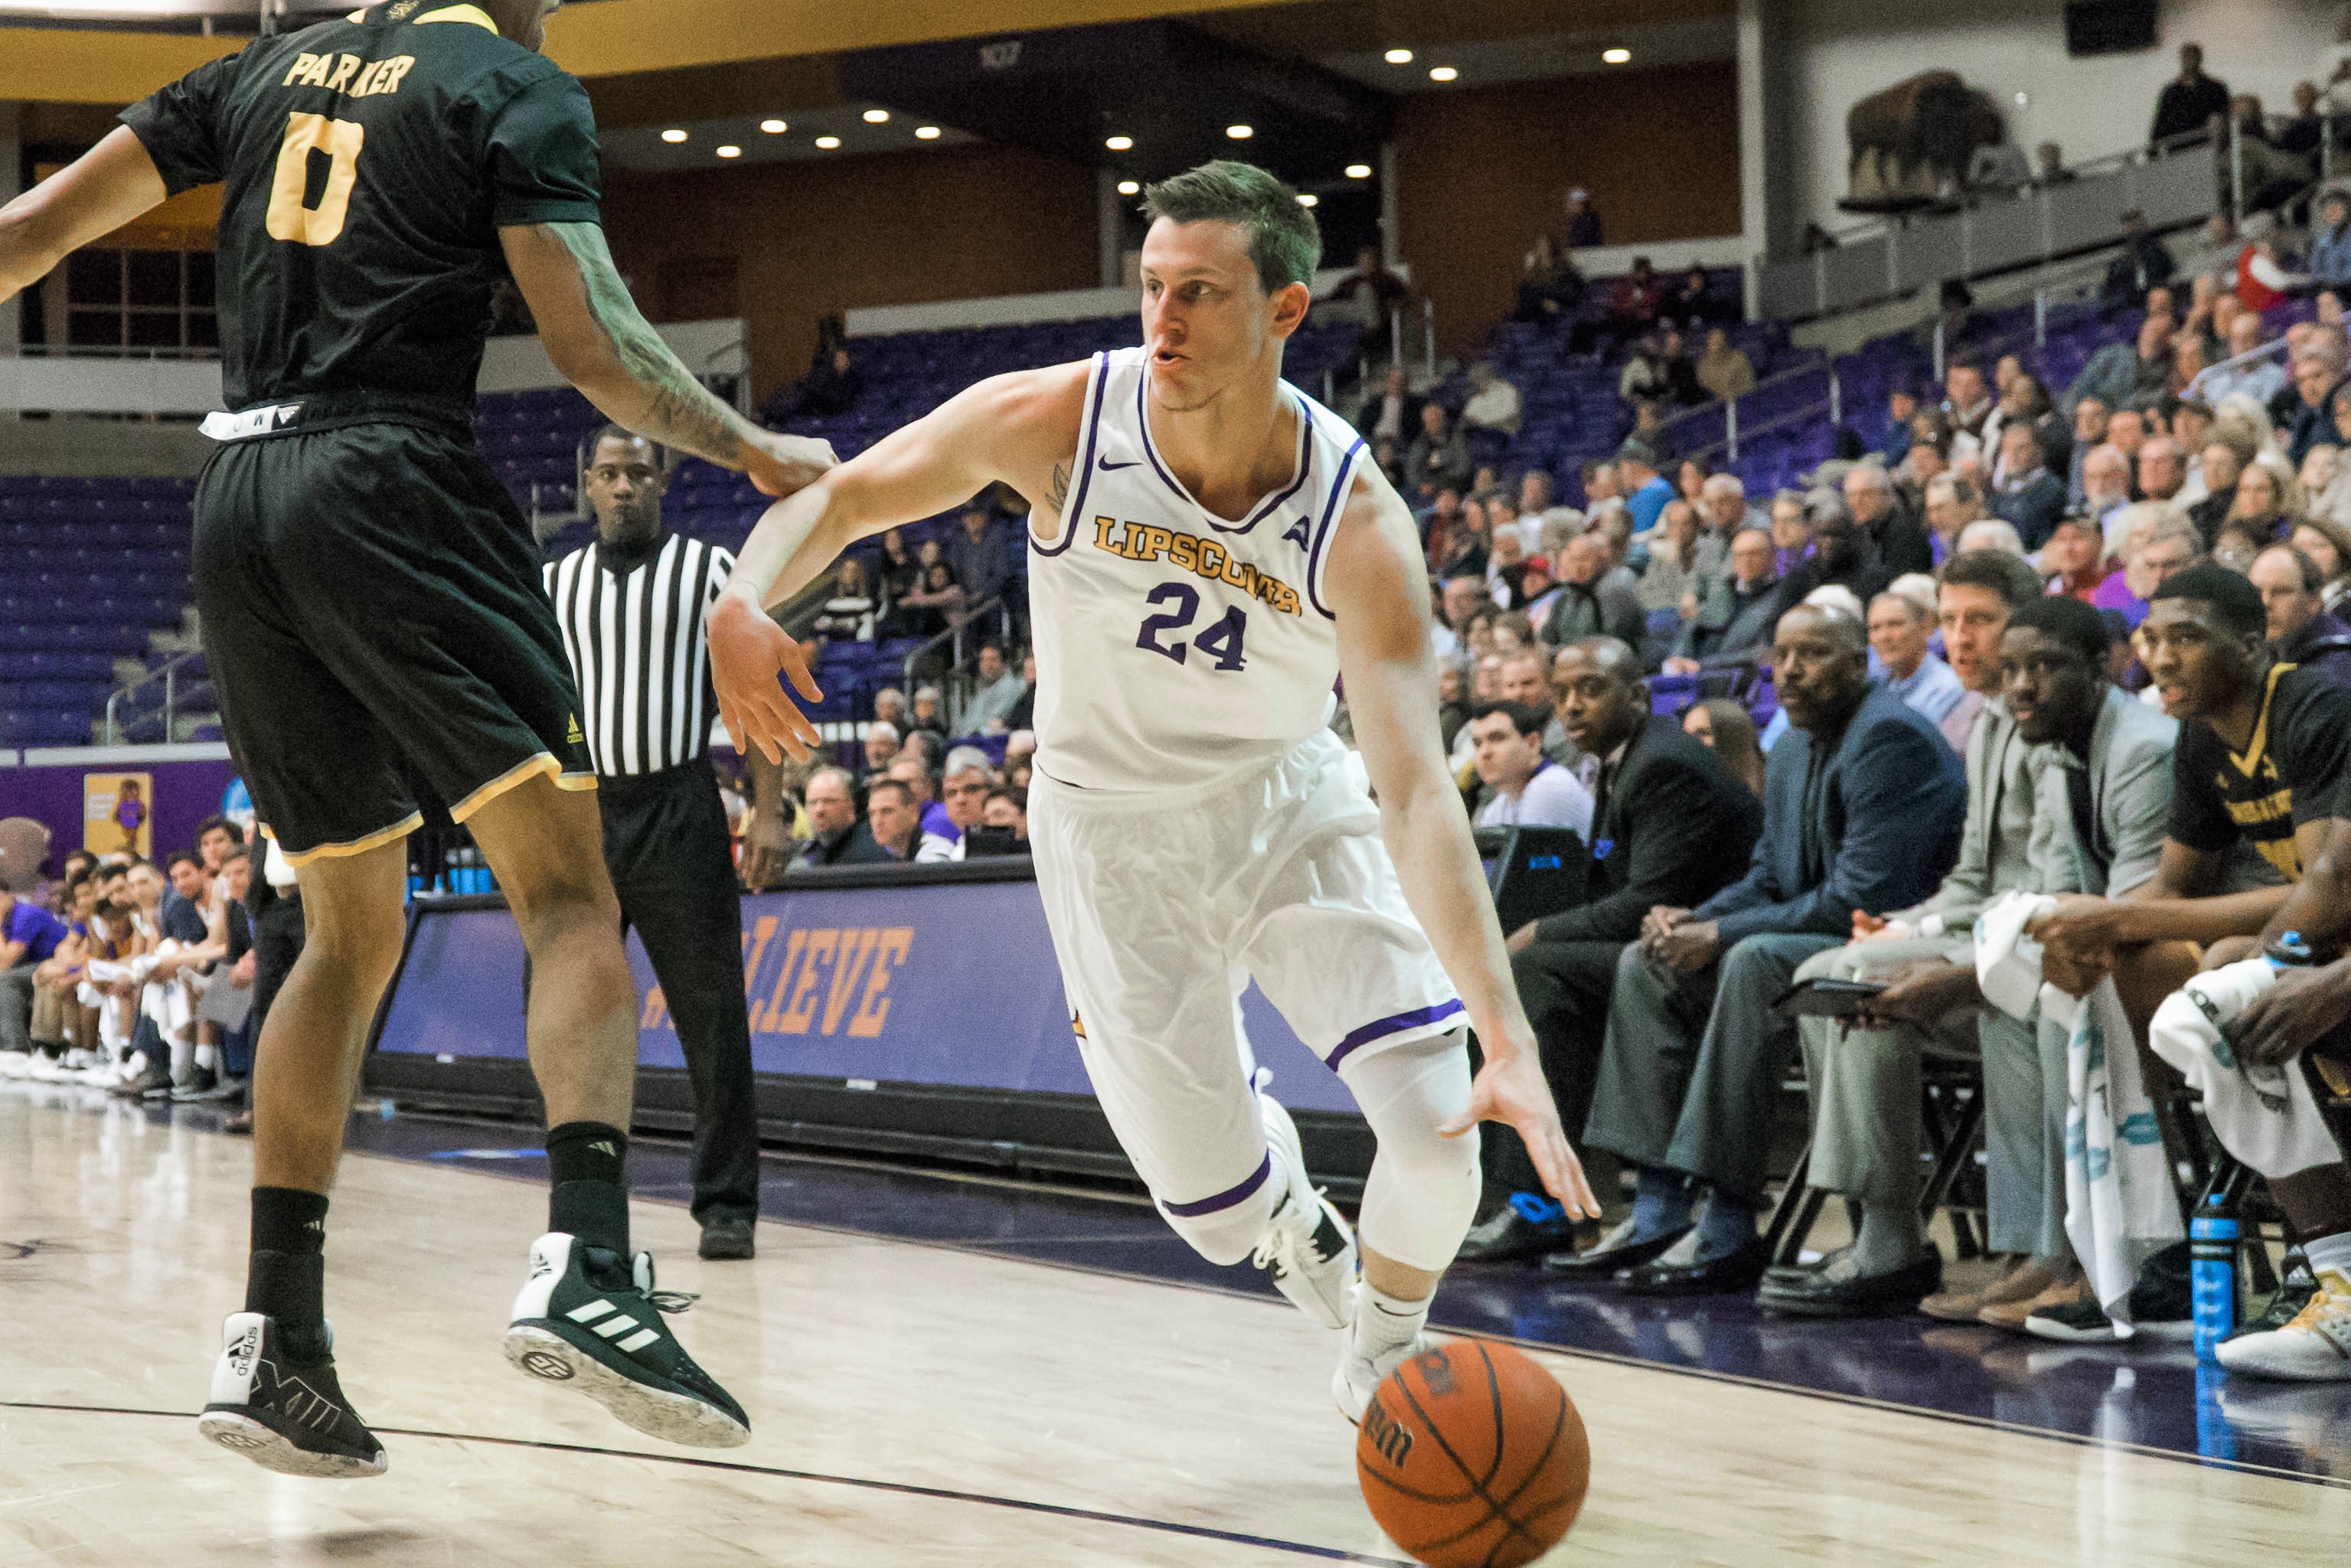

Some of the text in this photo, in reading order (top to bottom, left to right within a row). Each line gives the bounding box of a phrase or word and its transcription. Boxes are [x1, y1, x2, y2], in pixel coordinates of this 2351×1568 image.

[282, 52, 416, 99] PARKER
[266, 111, 364, 247] 0
[1135, 582, 1247, 671] 24
[237, 1325, 258, 1377] adidas
